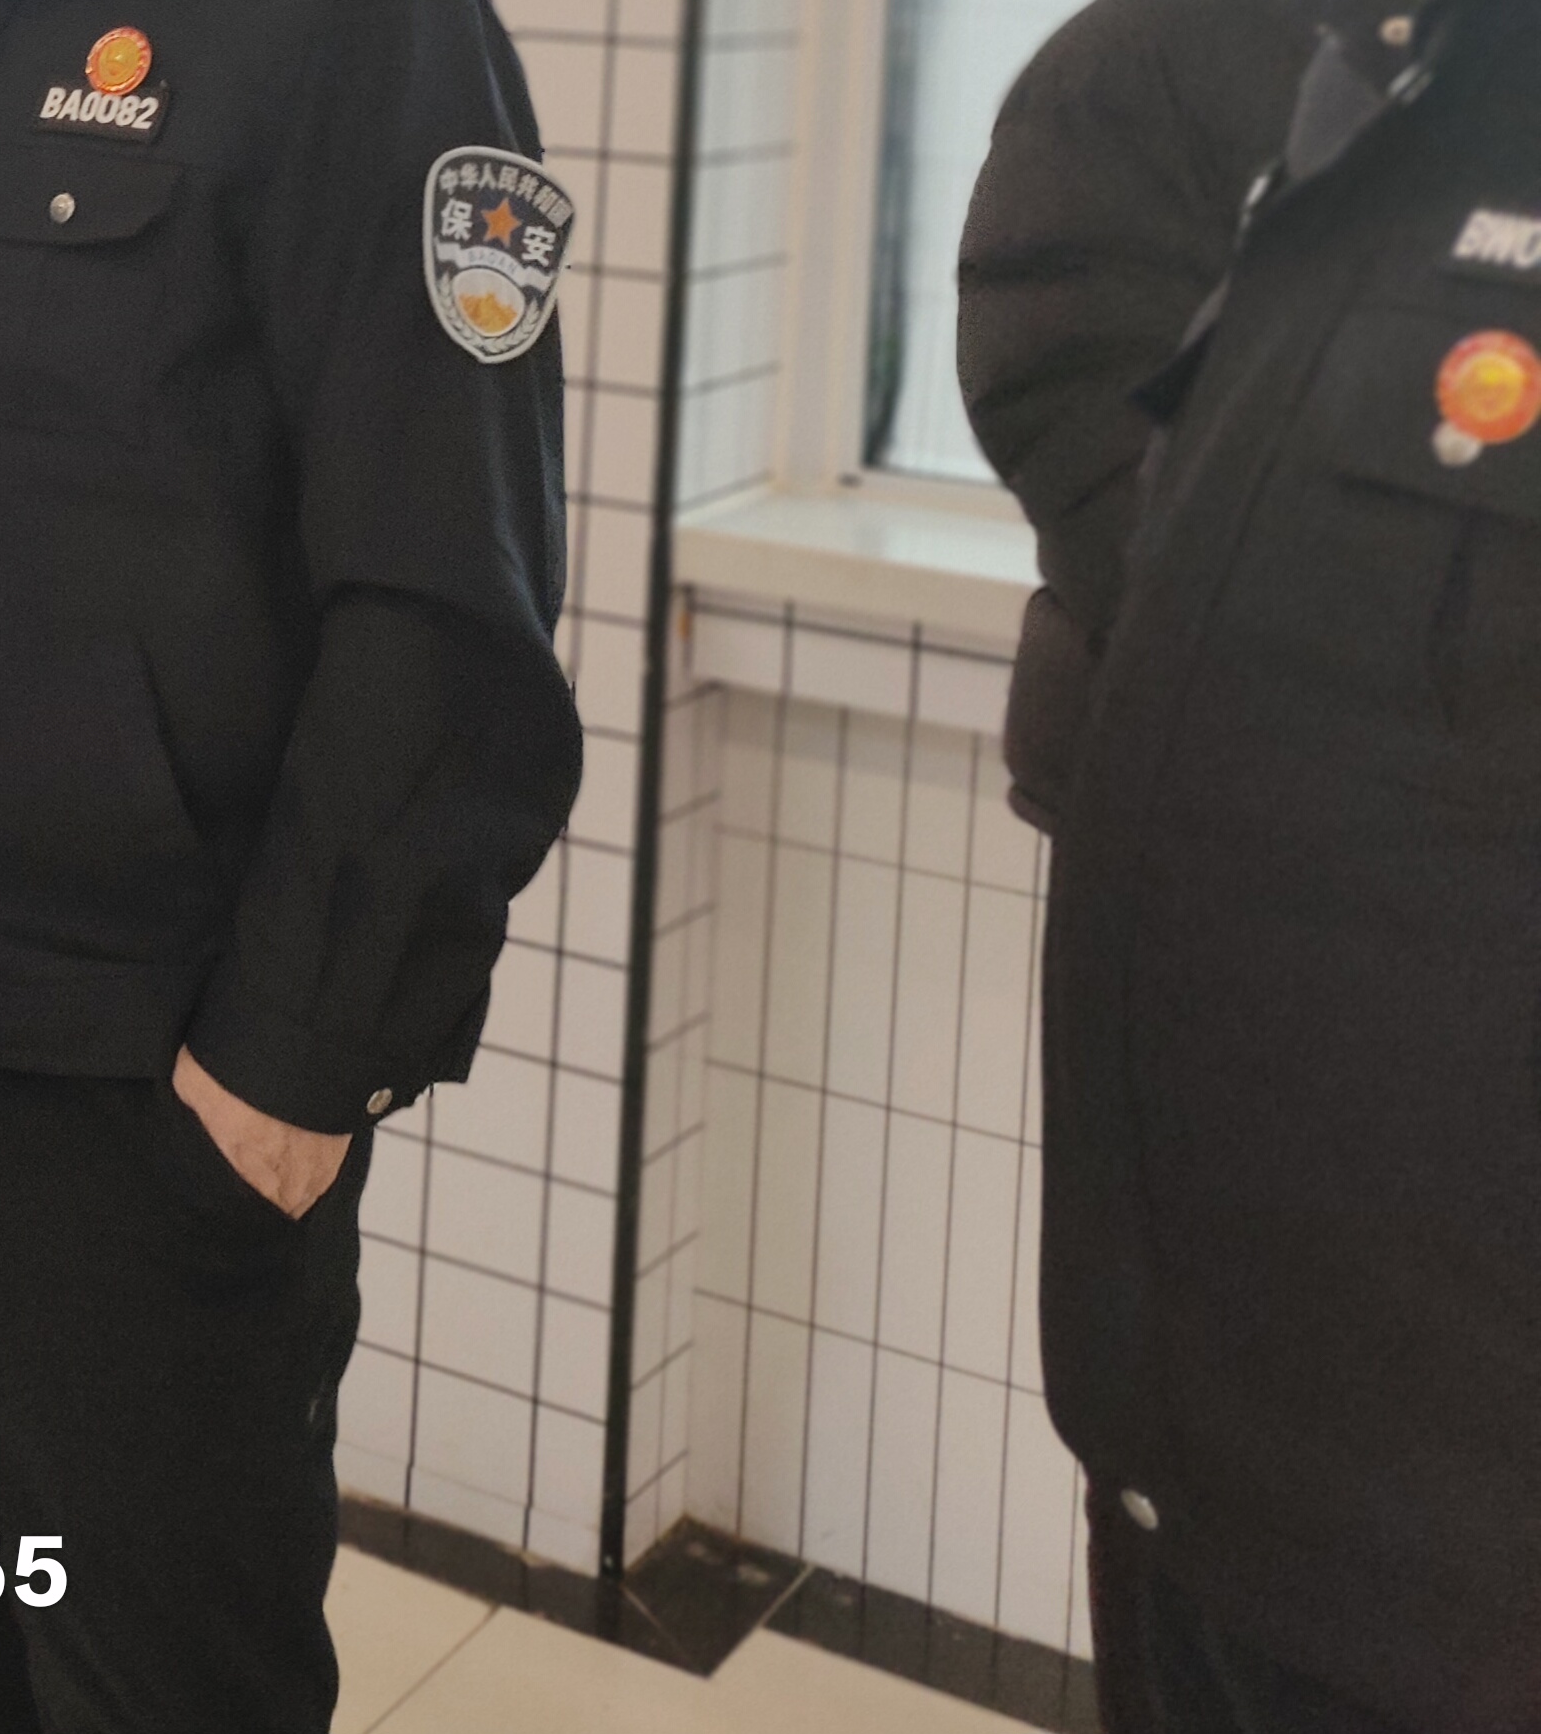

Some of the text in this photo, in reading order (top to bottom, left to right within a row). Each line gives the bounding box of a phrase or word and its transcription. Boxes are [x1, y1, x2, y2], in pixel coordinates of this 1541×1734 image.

[39, 86, 159, 130] BA0082
[438, 162, 574, 228] 中华人民共和国
